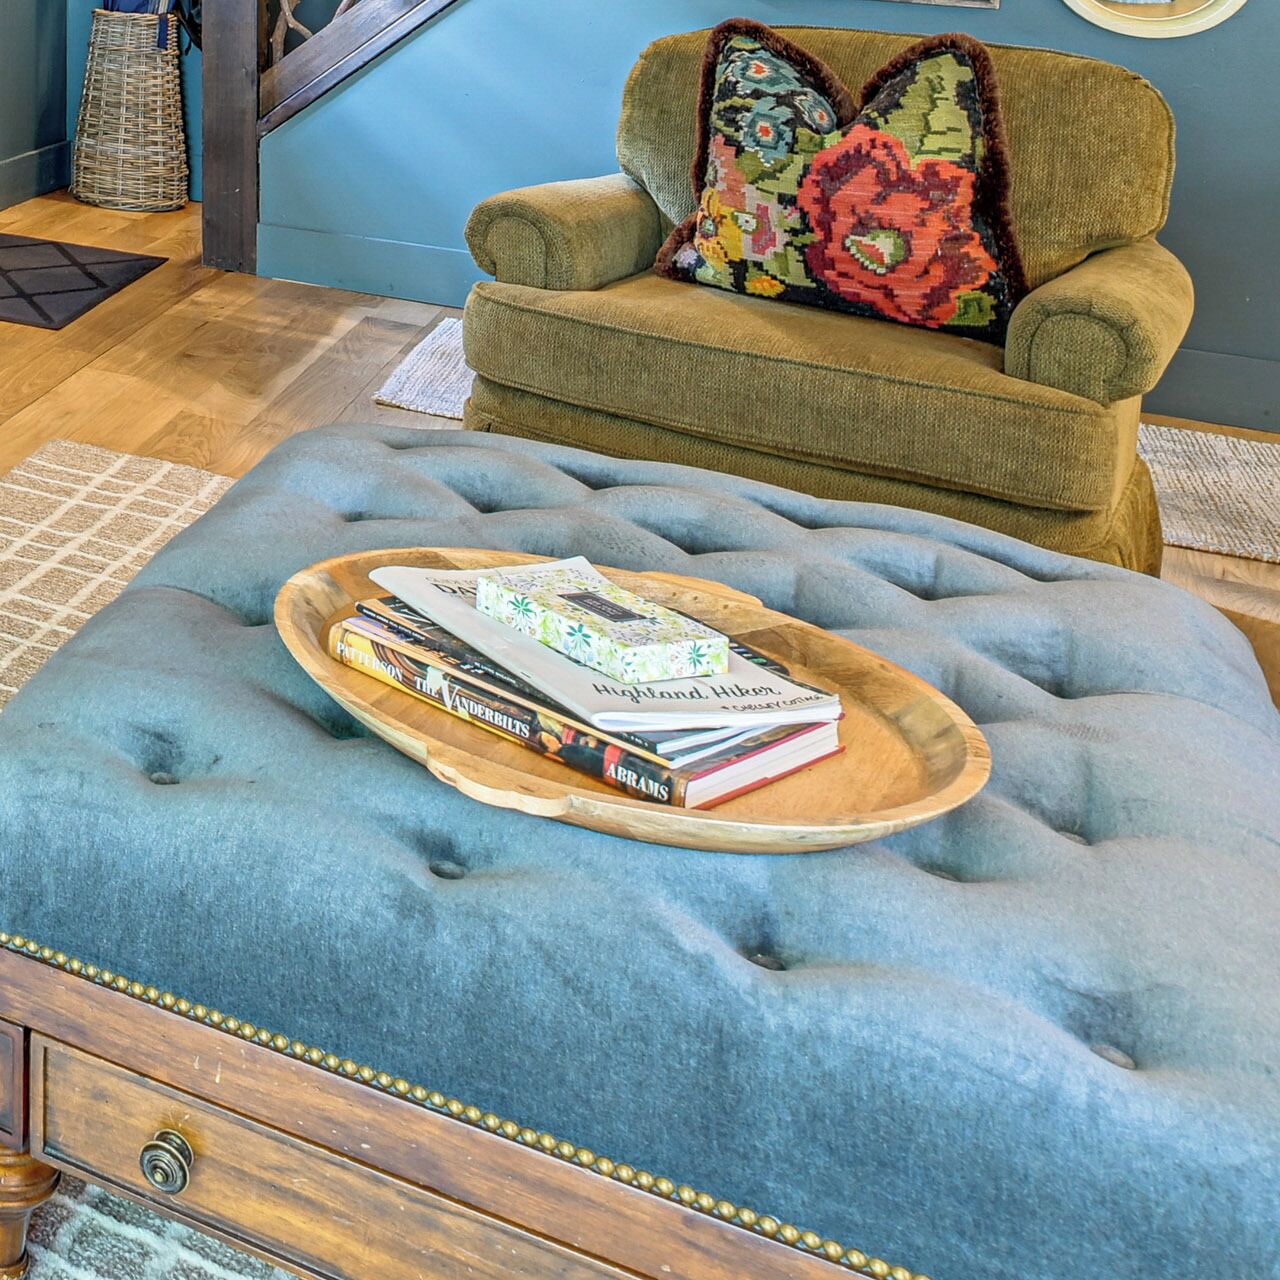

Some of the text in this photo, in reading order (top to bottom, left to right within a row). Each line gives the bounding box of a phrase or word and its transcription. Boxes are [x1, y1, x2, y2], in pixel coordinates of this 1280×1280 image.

[335, 640, 403, 682] PATTERSON
[414, 675, 531, 739] THE VANDERBILTS
[592, 682, 782, 704] Highland Hiker
[605, 761, 669, 801] ABRAMS
